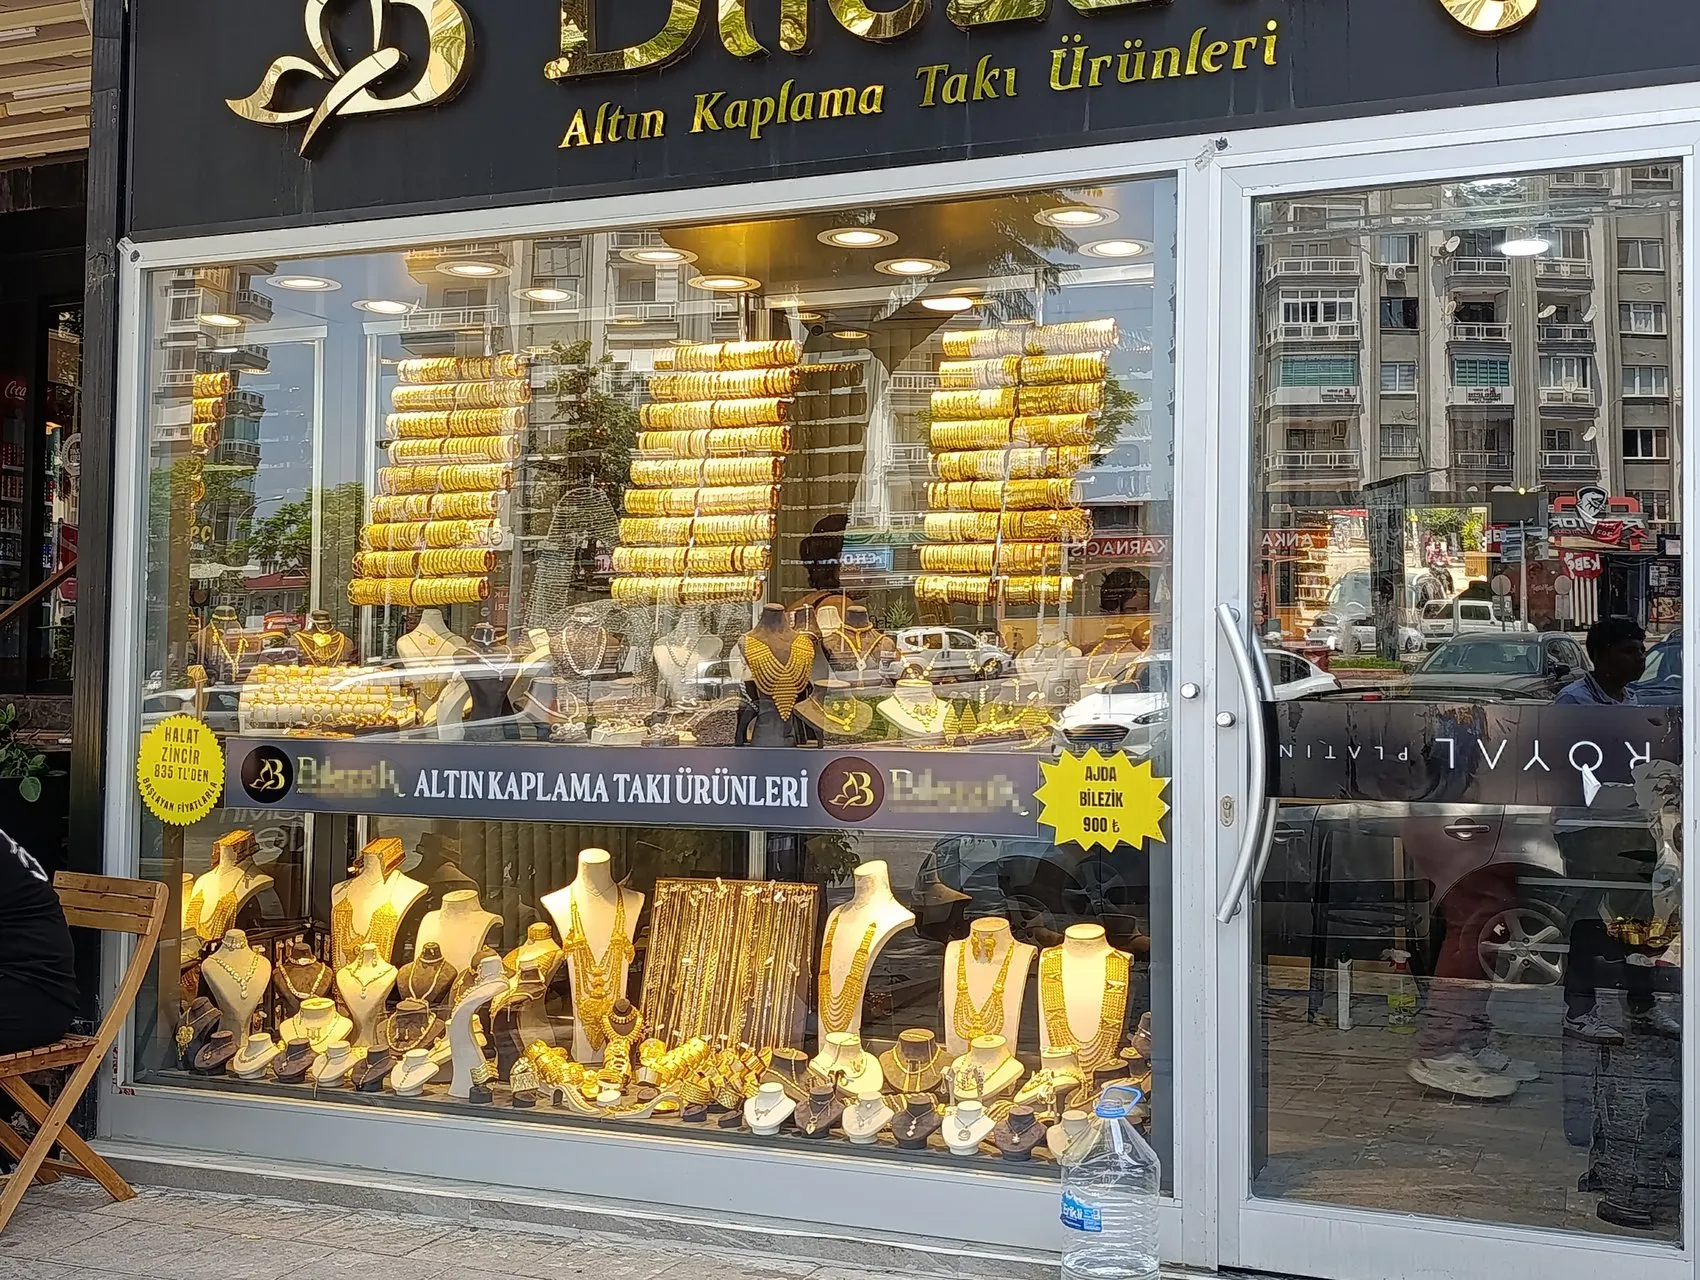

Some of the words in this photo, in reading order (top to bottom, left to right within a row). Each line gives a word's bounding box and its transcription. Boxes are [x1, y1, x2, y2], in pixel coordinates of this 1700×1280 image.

[558, 100, 666, 149] Altın
[692, 79, 885, 140] Kaplama
[916, 54, 1018, 108] Takı
[1049, 19, 1279, 92] Ürünleri
[164, 726, 201, 744] HALAT
[161, 744, 200, 765] ZİNCİR
[1280, 744, 1408, 762] PLATIN
[153, 763, 175, 780] 835
[178, 767, 209, 783] TL'DEN
[1084, 765, 1117, 782] AJDA
[142, 777, 175, 812] BAŞLAYAN
[177, 781, 218, 813] FİYATLARLA
[414, 769, 483, 799] ALTIN
[488, 771, 608, 802] KAPLAMA
[613, 774, 671, 804] TAKI
[672, 766, 809, 808] ÜRÜNLERİ
[1079, 787, 1124, 808] BİLEZİK
[1083, 816, 1107, 833] 900
